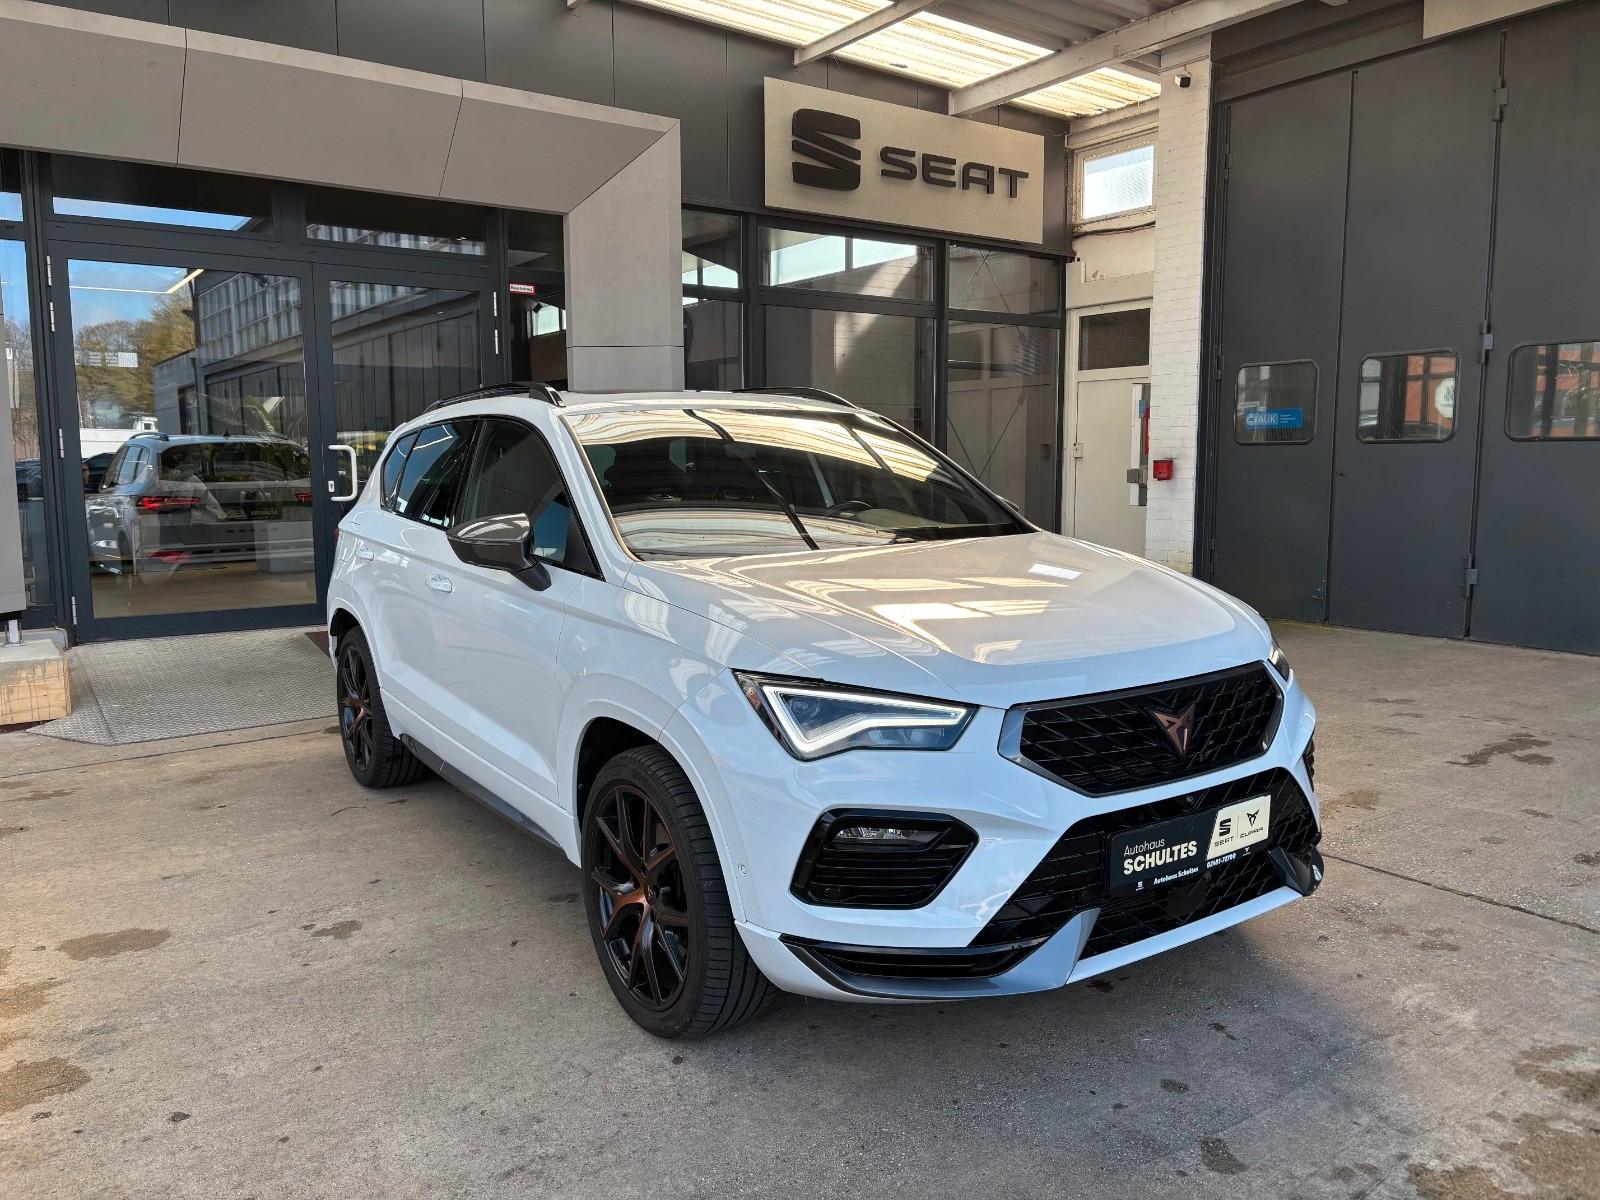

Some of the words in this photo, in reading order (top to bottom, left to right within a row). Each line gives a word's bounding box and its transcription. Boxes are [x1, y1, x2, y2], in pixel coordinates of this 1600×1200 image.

[879, 146, 1029, 198] SEAT
[1123, 837, 1166, 858] Autohaus
[1123, 840, 1198, 876] SCHULTES
